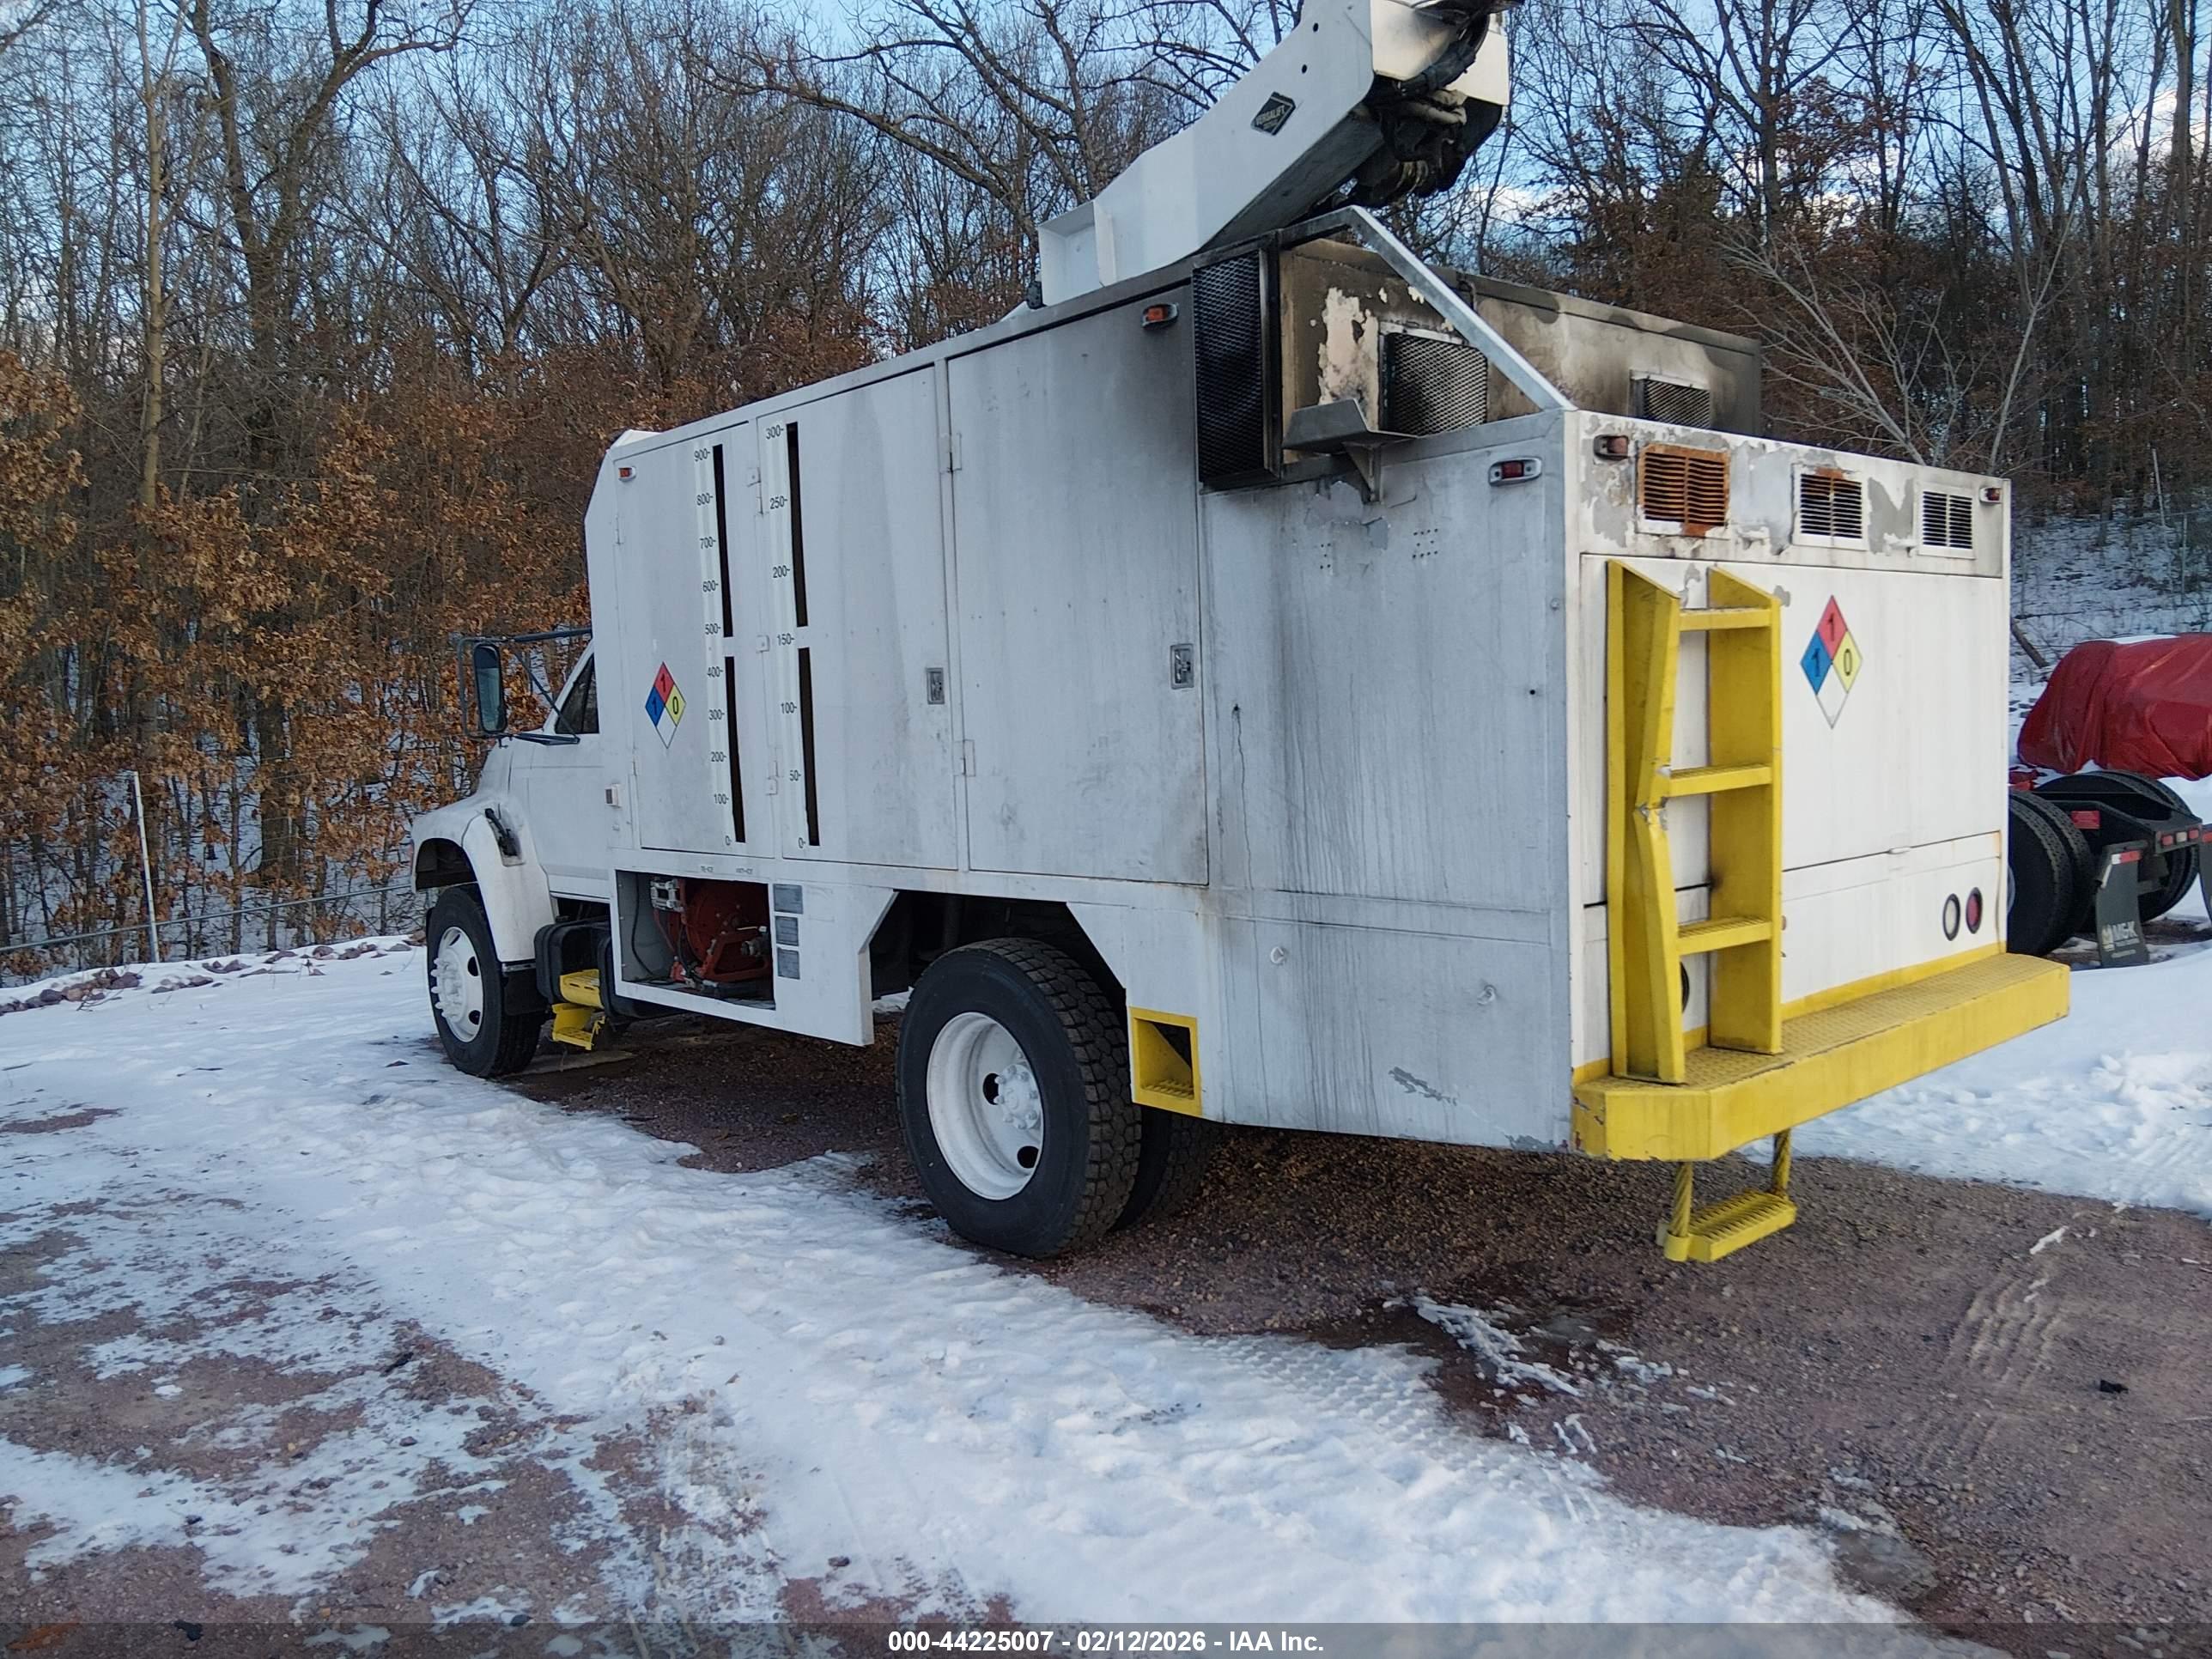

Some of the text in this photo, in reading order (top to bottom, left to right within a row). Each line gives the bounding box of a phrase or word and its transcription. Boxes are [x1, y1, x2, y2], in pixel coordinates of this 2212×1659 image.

[1827, 613, 1834, 641] 1
[1812, 647, 1852, 678] 1 0
[660, 673, 666, 693] 1
[652, 696, 679, 715] 1 0
